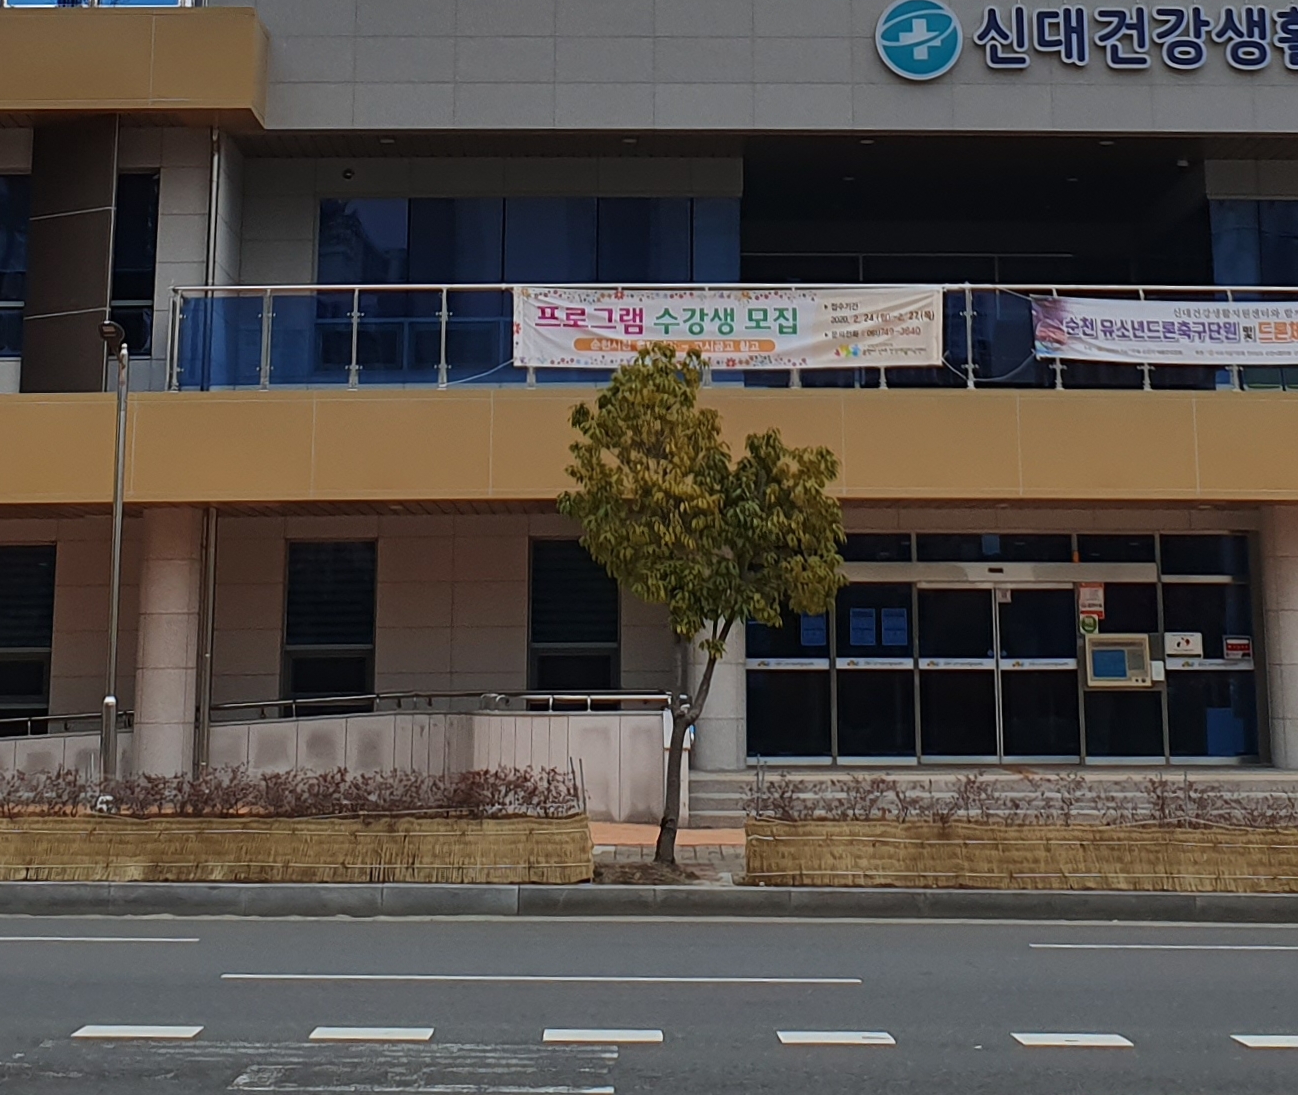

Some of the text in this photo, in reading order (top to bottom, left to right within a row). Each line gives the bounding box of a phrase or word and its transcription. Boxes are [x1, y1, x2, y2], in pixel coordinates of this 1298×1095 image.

[534, 306, 799, 336] 프로그램 수강생 모집
[1064, 316, 1097, 339] 순천
[1242, 326, 1254, 340] 및
